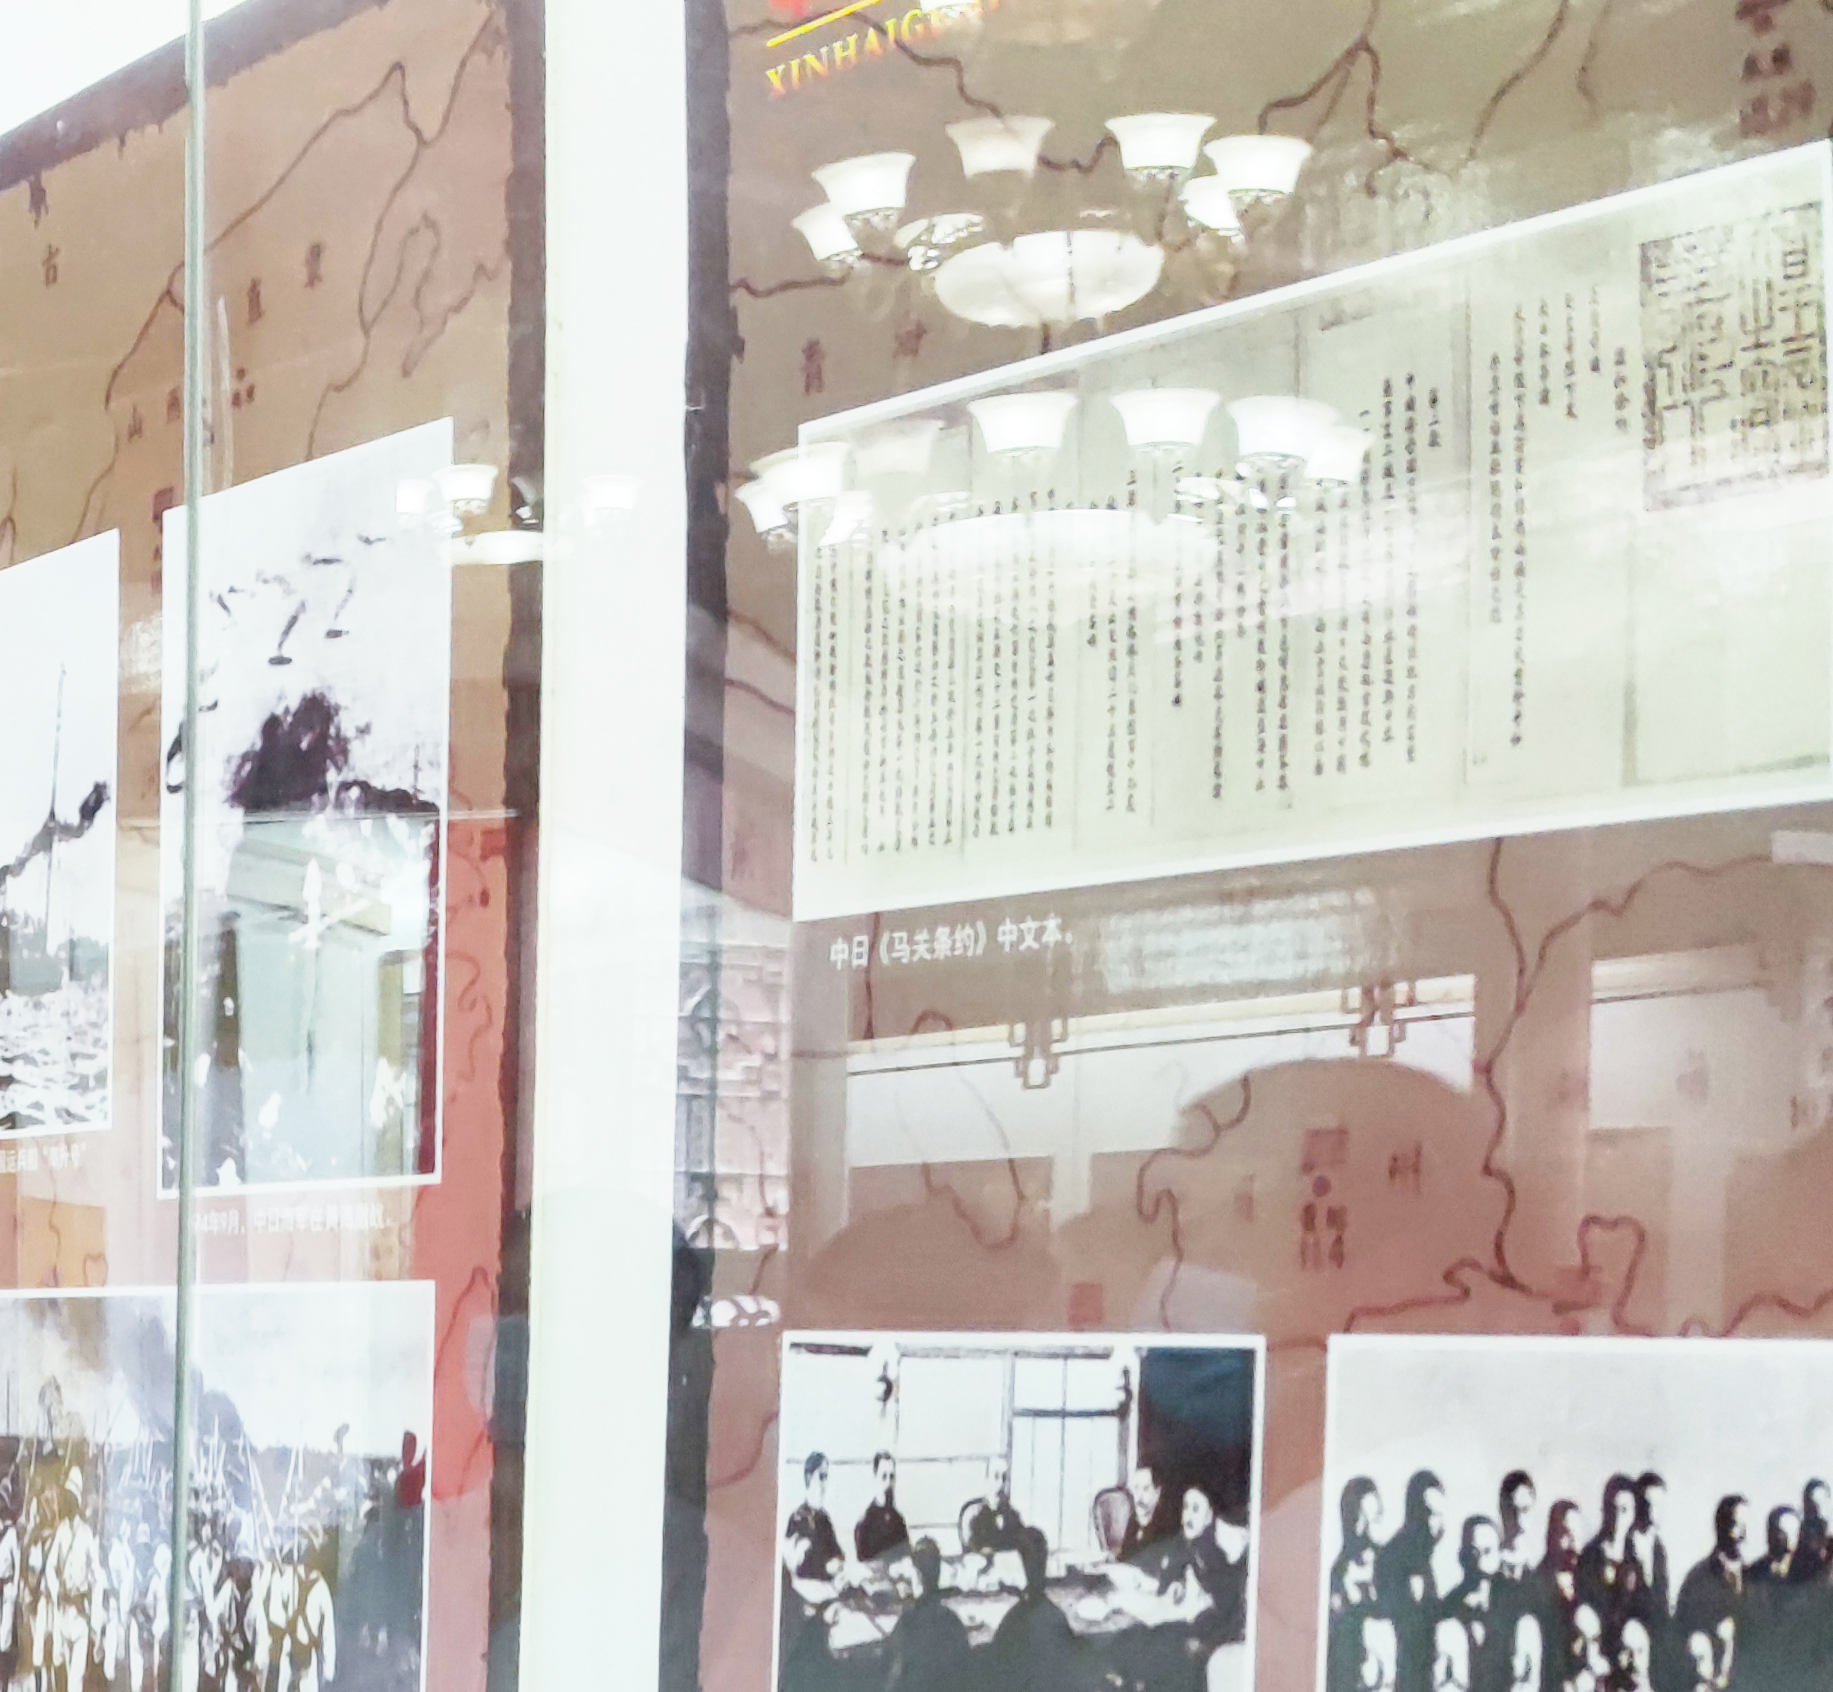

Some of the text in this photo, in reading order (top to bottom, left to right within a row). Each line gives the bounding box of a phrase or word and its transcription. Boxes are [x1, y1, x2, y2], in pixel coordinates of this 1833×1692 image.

[829, 917, 1074, 970] 中日《马关条约》中文本。
